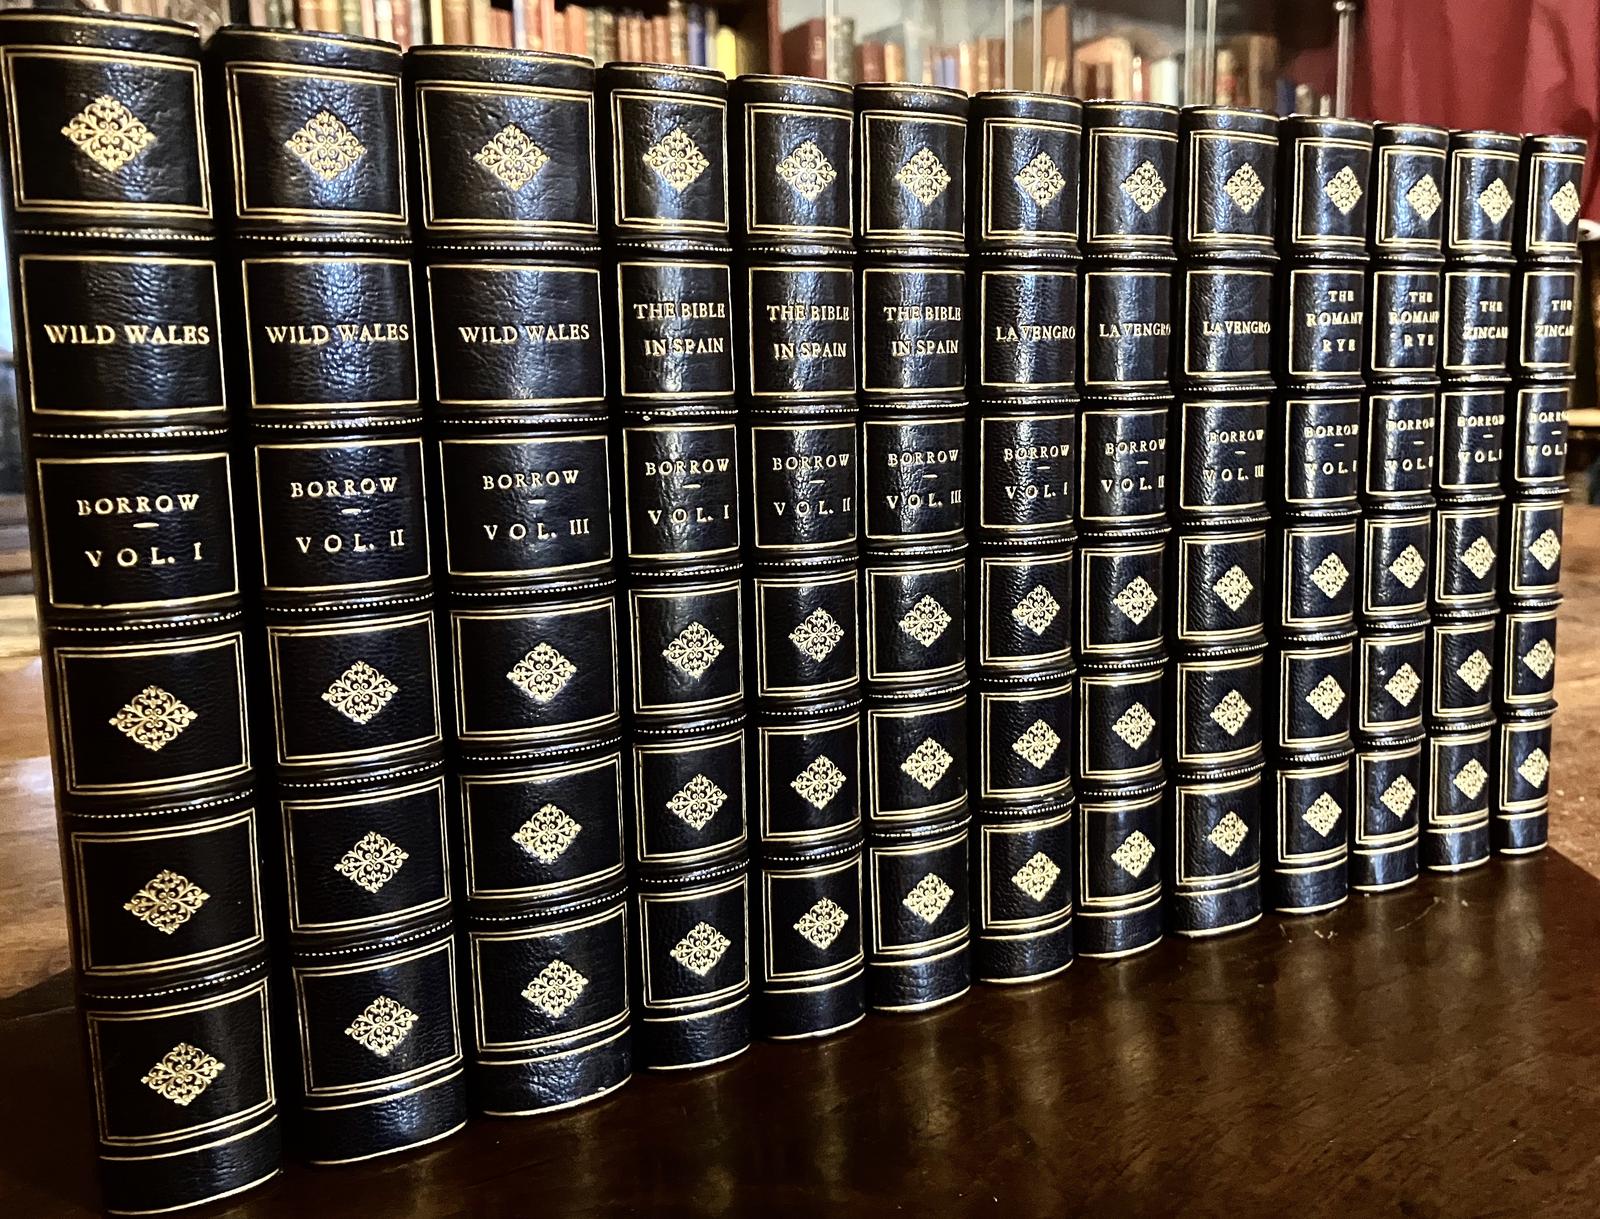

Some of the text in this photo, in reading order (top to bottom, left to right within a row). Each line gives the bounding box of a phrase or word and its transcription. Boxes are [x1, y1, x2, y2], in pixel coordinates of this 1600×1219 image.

[1328, 290, 1354, 302] THE
[1409, 292, 1433, 303] THE
[634, 303, 725, 319] THE BIBLE
[767, 305, 850, 321] THE BIBLE
[884, 306, 961, 321] THE BIBLE
[1479, 300, 1503, 312] THE
[44, 324, 210, 346] WILD WALES
[265, 323, 409, 345] WILD WALES
[458, 323, 590, 344] WILD WALES
[644, 338, 724, 356] IN SPAIN
[774, 343, 846, 358] IN SPAIN
[892, 340, 958, 356] IN SPAIN
[1209, 429, 1264, 443] BORROW
[1004, 445, 1070, 461] BORROW
[1105, 438, 1166, 456] BORROW
[773, 454, 849, 471] BORROW
[888, 449, 958, 467] BORROW
[646, 459, 729, 476] BORROW
[291, 476, 398, 498] BORROW
[483, 470, 580, 490] BORROW
[886, 490, 962, 510] VOL. III
[1005, 485, 1056, 499] VOL.
[77, 494, 200, 516] BORROW
[774, 497, 851, 516] VOL. II
[648, 504, 729, 525] VOL. I
[484, 518, 590, 541] VOL. III
[296, 529, 404, 555] VOL. II
[85, 543, 202, 568] VOL. I
